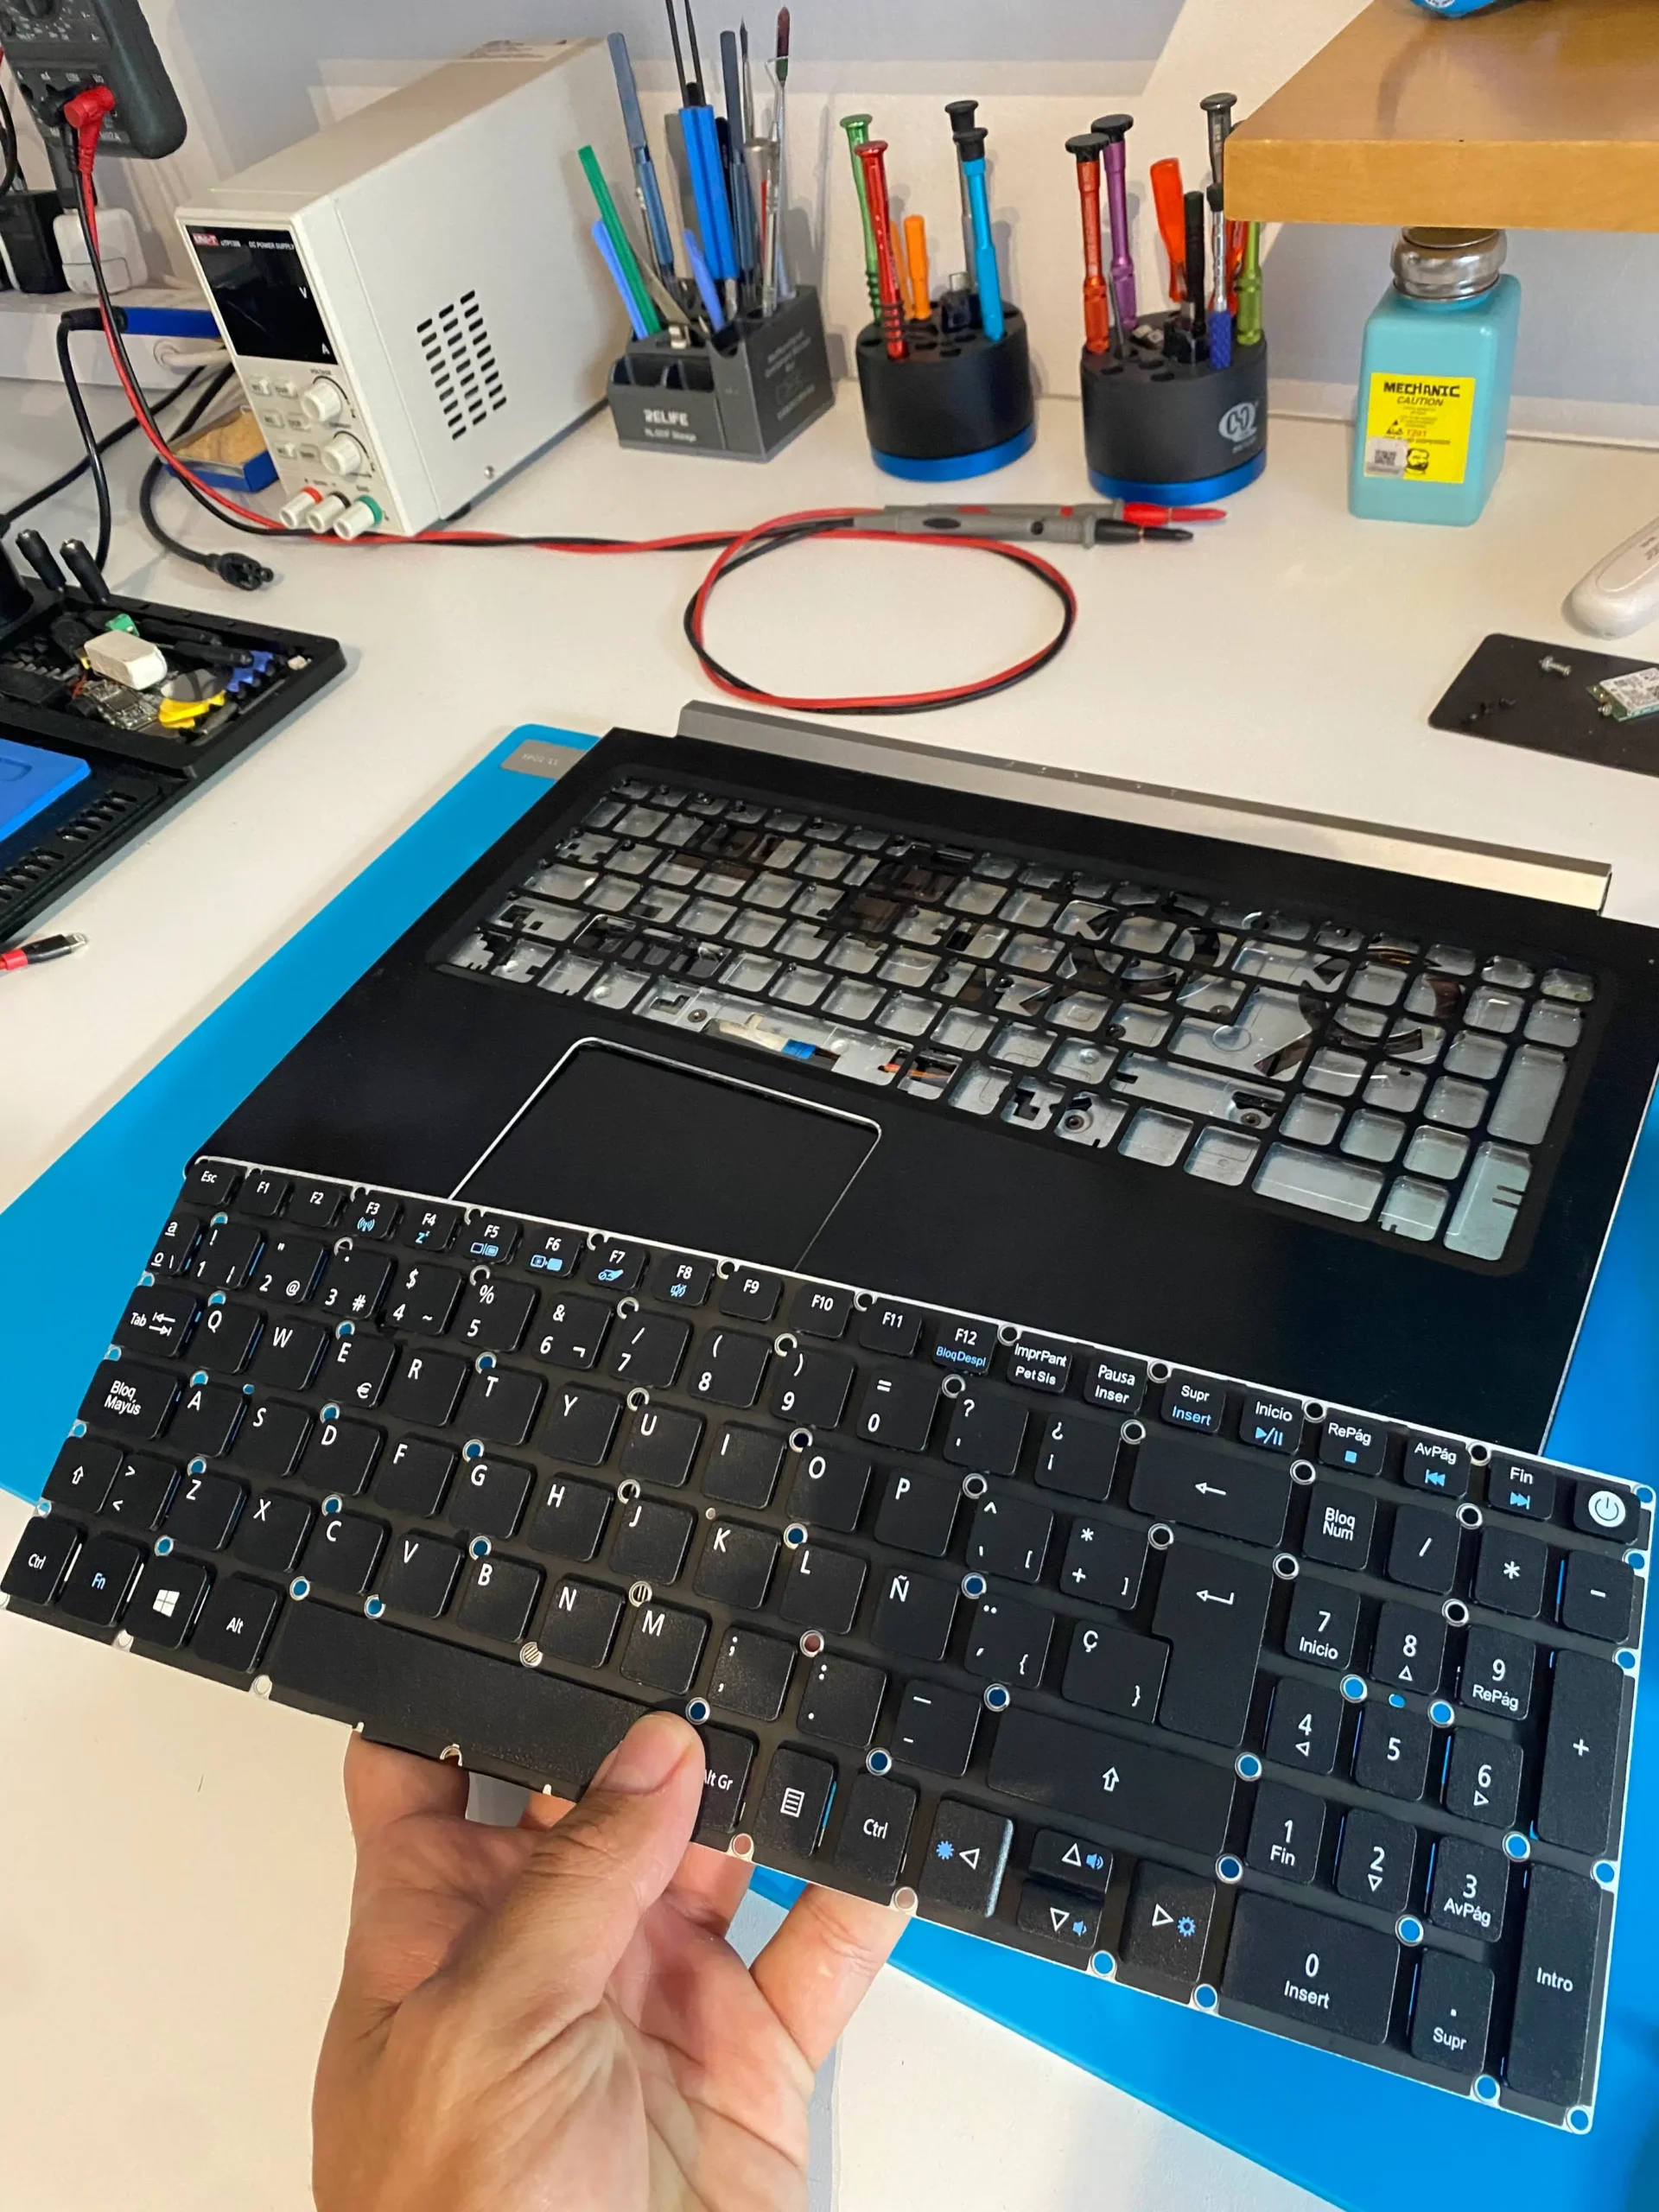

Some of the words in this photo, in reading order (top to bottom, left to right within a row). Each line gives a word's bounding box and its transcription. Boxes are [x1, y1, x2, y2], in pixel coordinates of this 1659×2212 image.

[299, 287, 308, 299] V
[321, 343, 330, 355] A
[1383, 382, 1460, 397] MECHANIC
[1396, 396, 1444, 406] CAUTION
[201, 1171, 217, 1183] Esc
[257, 1181, 270, 1193] F1
[310, 1192, 323, 1205] F2
[365, 1202, 380, 1215] F3
[423, 1213, 436, 1226] F4
[485, 1225, 499, 1237] F5
[545, 1237, 561, 1251] F6
[609, 1250, 626, 1263] F7
[198, 1262, 206, 1277] 1
[406, 1268, 418, 1288] $
[677, 1265, 692, 1279] F8
[259, 1274, 272, 1292] 2
[286, 1281, 300, 1296] @
[480, 1285, 494, 1304] %
[744, 1280, 760, 1294] F9
[325, 1288, 338, 1305] 3
[353, 1294, 365, 1312] #
[811, 1294, 833, 1311] F10
[130, 1313, 146, 1326] Tab
[208, 1311, 222, 1332] Q
[393, 1304, 405, 1320] 4
[553, 1305, 565, 1322] &
[882, 1312, 903, 1327] F11
[273, 1327, 293, 1348] W
[467, 1319, 480, 1337] 5
[632, 1327, 645, 1344] /
[955, 1328, 976, 1345] F12
[338, 1343, 351, 1362] E
[540, 1336, 553, 1354] 6
[713, 1335, 722, 1357] (
[618, 1353, 631, 1371] 7
[794, 1354, 803, 1376] )
[937, 1346, 986, 1367] BloqDespl
[1014, 1344, 1066, 1367] ImprPant
[408, 1359, 422, 1379] R
[1098, 1364, 1135, 1386] Pausa
[111, 1381, 136, 1401] Bloq
[357, 1382, 372, 1398] €
[486, 1376, 499, 1396] T
[699, 1372, 711, 1391] 8
[877, 1380, 892, 1392] =
[188, 1391, 201, 1410] A
[782, 1392, 794, 1410] 9
[1096, 1385, 1129, 1403] Inser
[1181, 1385, 1210, 1402] Supr
[105, 1395, 141, 1414] Mayús
[564, 1395, 578, 1416] Y
[964, 1399, 975, 1416] ?
[1255, 1402, 1292, 1421] Inicio
[253, 1408, 266, 1427] S
[641, 1414, 657, 1435] U
[868, 1414, 880, 1432] 0
[1173, 1406, 1211, 1426] Insert
[321, 1425, 337, 1445] D
[1052, 1422, 1063, 1440] ¿
[1328, 1422, 1371, 1446] RePág
[393, 1444, 408, 1464] F
[721, 1433, 729, 1455] I
[1414, 1443, 1456, 1465] AvPág
[471, 1465, 487, 1485] G
[809, 1457, 825, 1478] O
[1510, 1467, 1533, 1484] Fin
[187, 1479, 201, 1500] Z
[548, 1484, 565, 1507] H
[895, 1478, 910, 1499] P
[253, 1499, 270, 1521] X
[629, 1506, 641, 1527] J
[1325, 1507, 1356, 1529] Bloq
[327, 1521, 341, 1541] C
[714, 1528, 730, 1552] K
[1323, 1522, 1353, 1541] Num
[404, 1541, 418, 1563] V
[1419, 1538, 1432, 1556] /
[29, 1554, 46, 1569] Ctrl
[801, 1550, 810, 1574] L
[92, 1573, 105, 1589] Fn
[478, 1563, 493, 1586] B
[1072, 1568, 1085, 1582] +
[559, 1586, 576, 1611] N
[890, 1575, 909, 1602] Ñ
[226, 1618, 243, 1633] Alt
[642, 1610, 664, 1636] M
[1319, 1611, 1331, 1631] 7
[1084, 1630, 1098, 1652] Ç
[1300, 1637, 1338, 1659] Inicio
[1403, 1635, 1416, 1656] 8
[1492, 1659, 1505, 1681] 9
[1473, 1684, 1518, 1712] RePág
[1299, 1714, 1312, 1735] 4
[1388, 1738, 1401, 1760] 5
[1573, 1739, 1589, 1756] +
[717, 1775, 733, 1790] Gr
[1478, 1764, 1491, 1788] 6
[863, 1819, 888, 1839] Ctrl
[1285, 1821, 1293, 1843] 1
[1270, 1845, 1294, 1866] Fin
[1370, 1847, 1384, 1872] 2
[1463, 1874, 1477, 1898] 3
[1444, 1897, 1491, 1927] AvPág
[1306, 1954, 1319, 1977] 0
[1537, 1967, 1573, 1992] Intro
[1285, 1980, 1329, 2009] Insert
[1433, 2027, 1466, 2050] Supr
